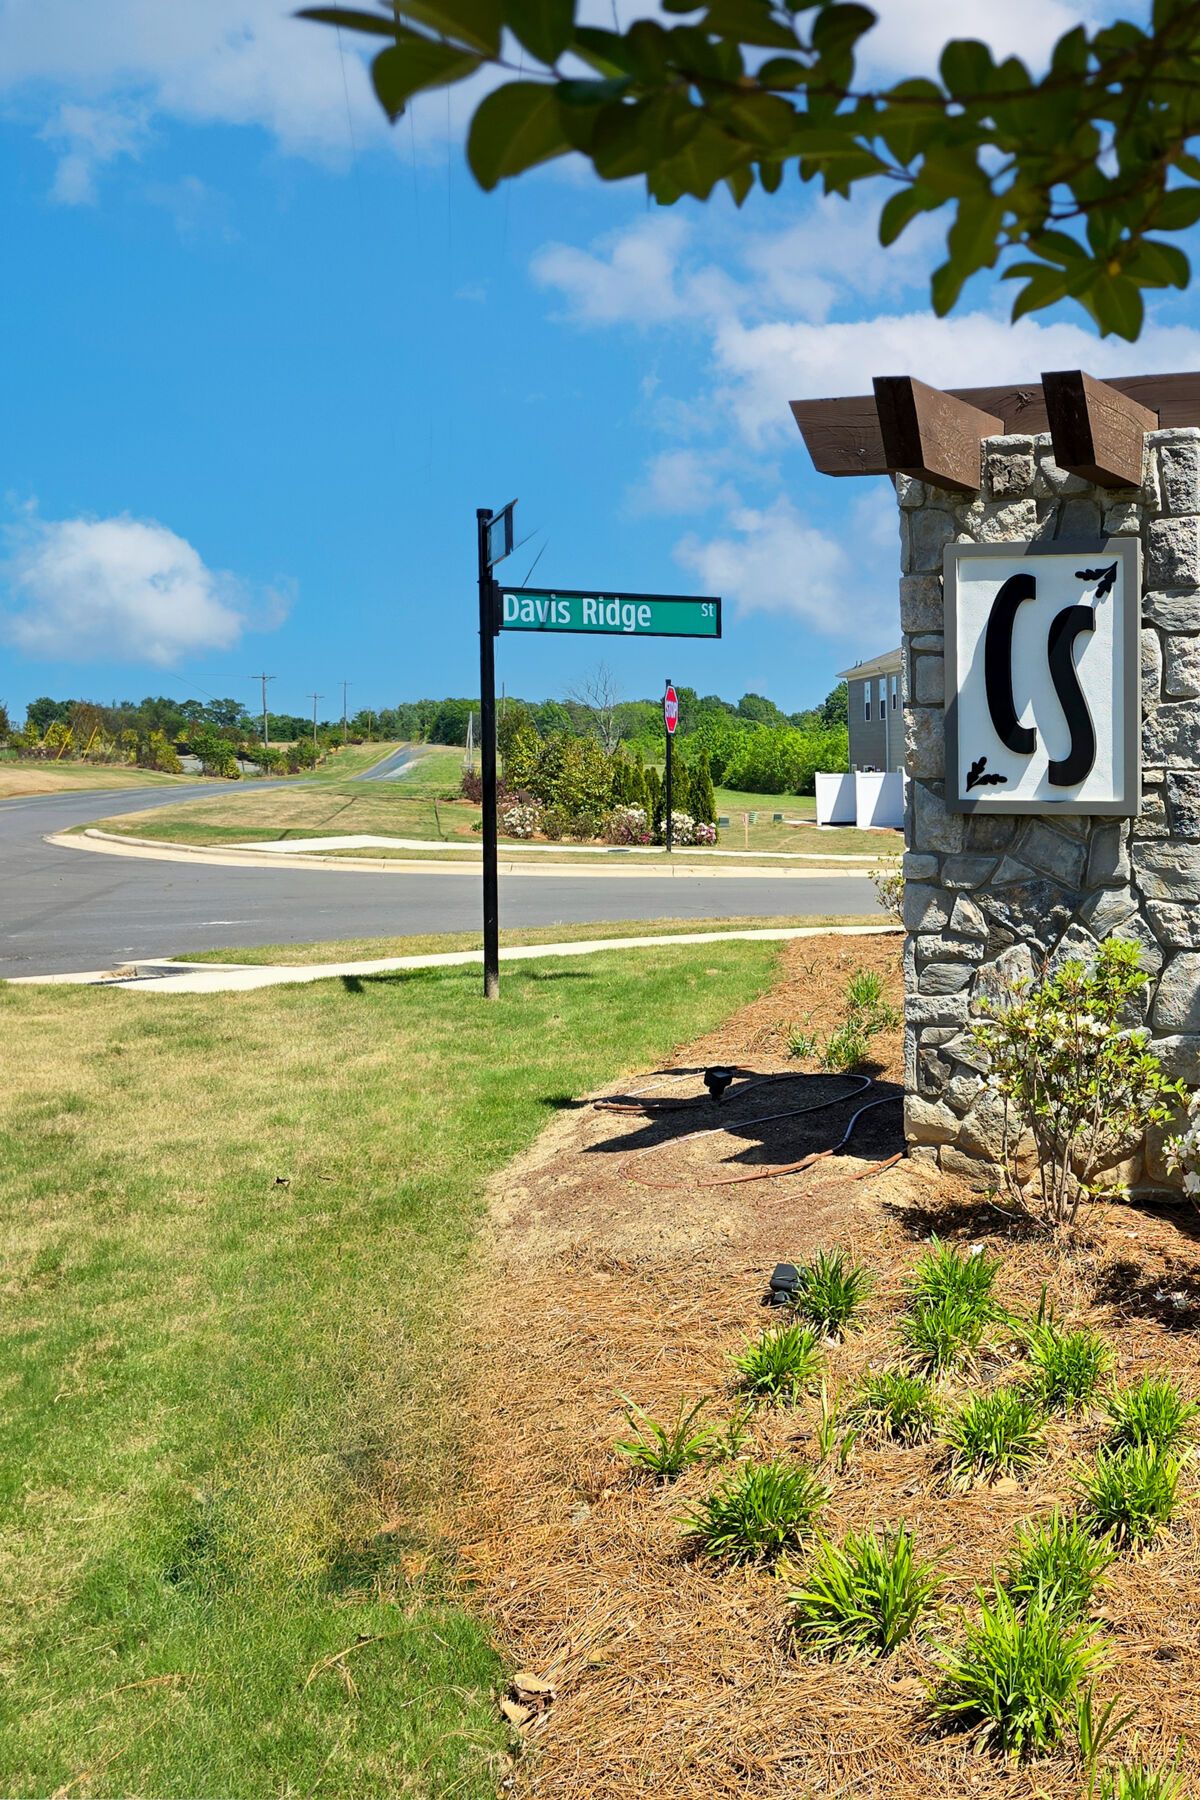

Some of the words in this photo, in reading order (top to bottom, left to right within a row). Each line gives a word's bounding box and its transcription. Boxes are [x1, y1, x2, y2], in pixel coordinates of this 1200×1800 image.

[503, 593, 571, 624] Davis
[582, 596, 652, 632] Ridge
[701, 602, 714, 617] St
